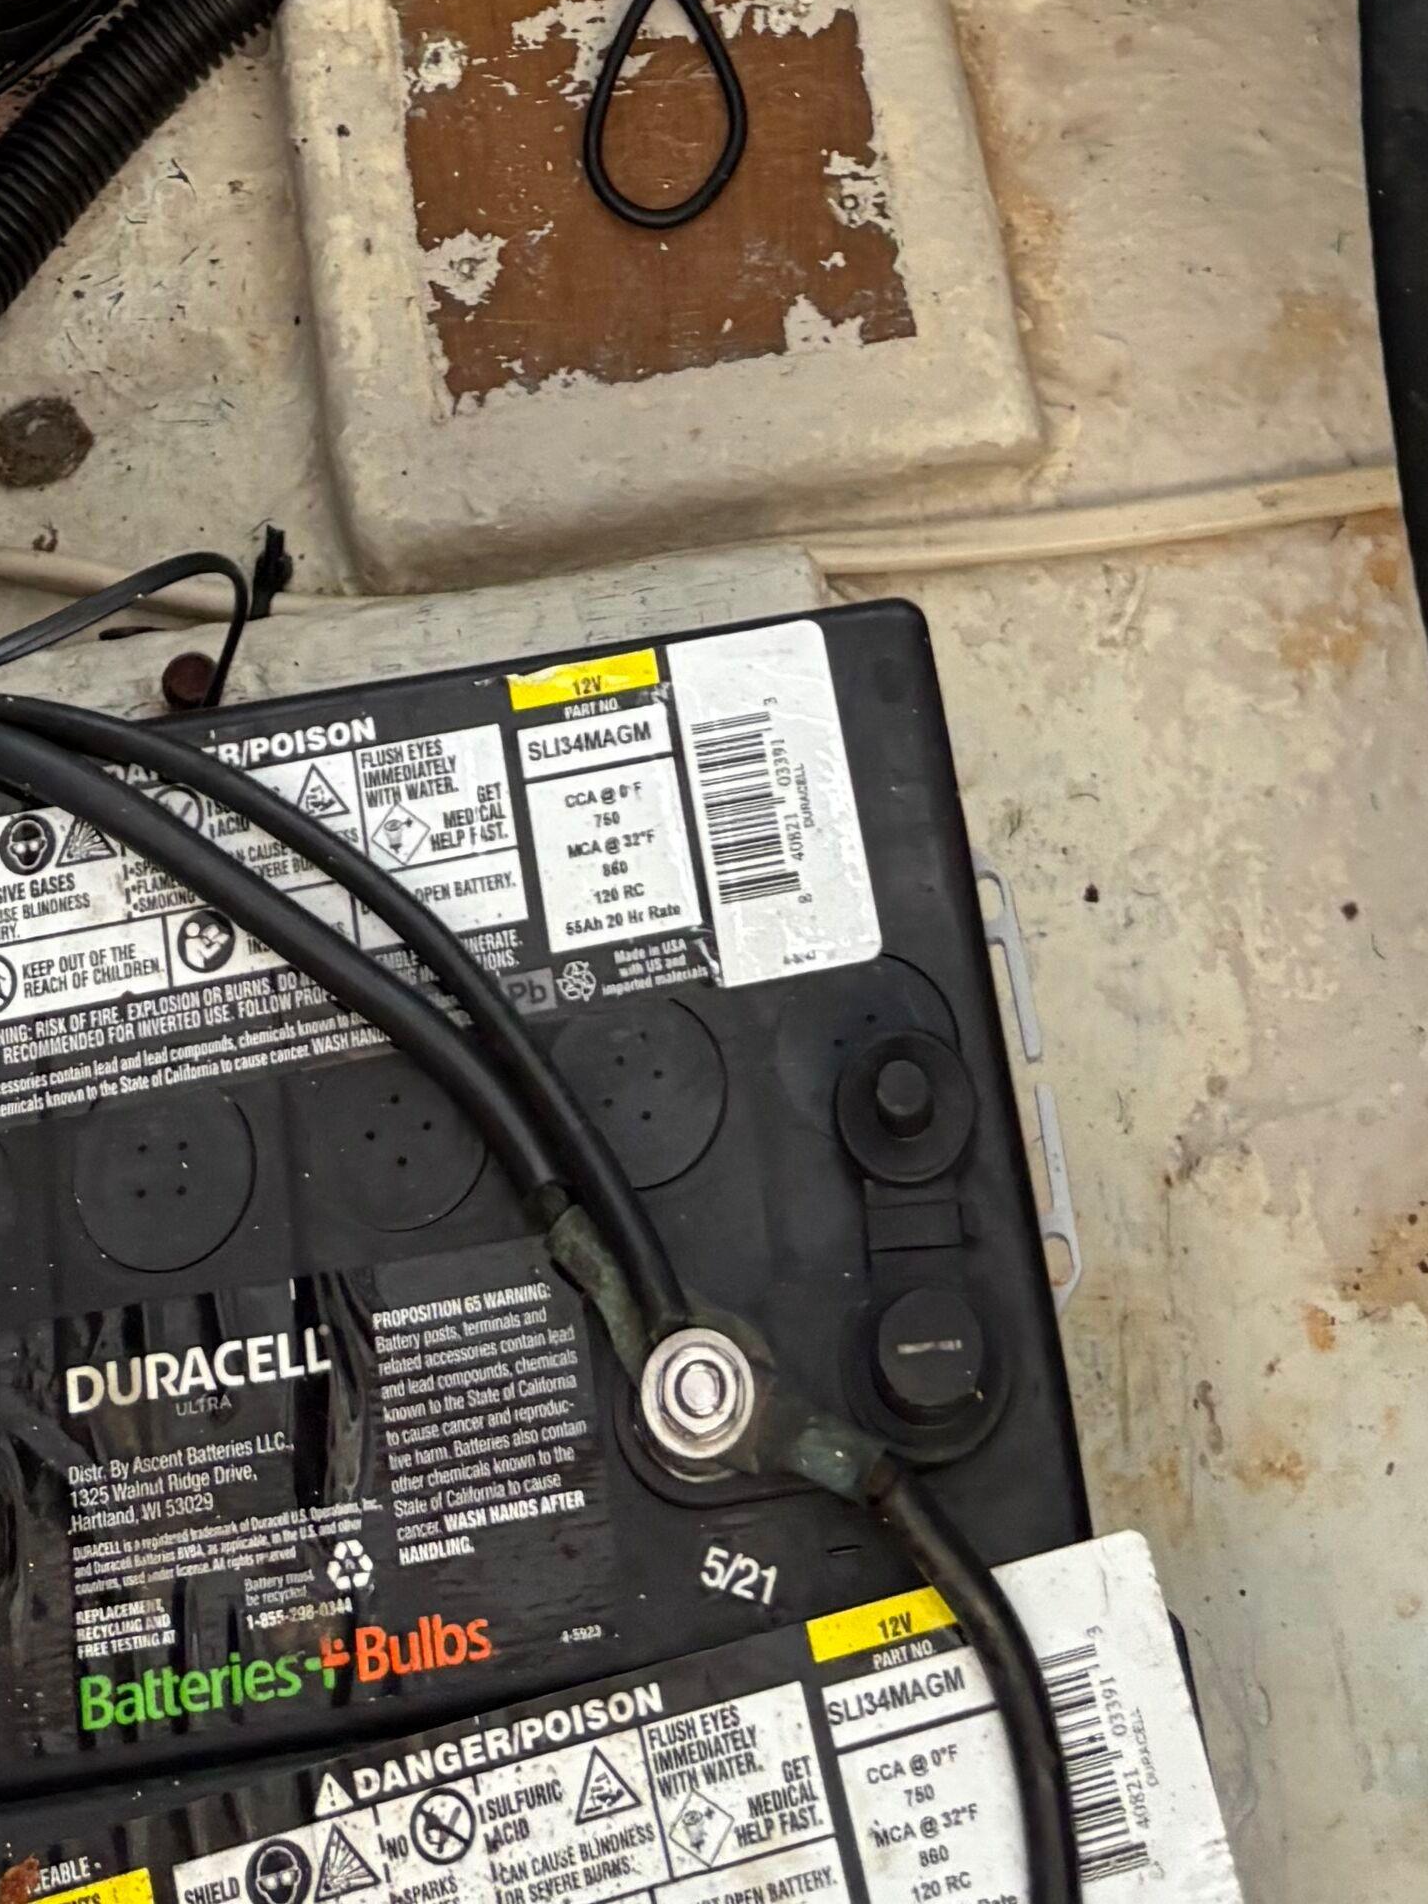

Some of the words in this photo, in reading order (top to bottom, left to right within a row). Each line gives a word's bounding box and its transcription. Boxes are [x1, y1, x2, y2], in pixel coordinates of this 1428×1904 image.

[571, 674, 604, 697] 12V
[563, 700, 598, 720] PART
[598, 696, 620, 714] NO.
[104, 715, 378, 789] DAR/POISON
[359, 745, 404, 770] FLUSH
[406, 737, 444, 761] EYES
[525, 719, 652, 762] SLI34MAGM
[361, 754, 459, 789] IMMEDIATELY
[770, 737, 793, 788] 03391
[364, 784, 403, 808] WITH
[404, 773, 460, 801] WATER.
[475, 780, 504, 804] GET
[563, 789, 598, 809] CCA
[598, 785, 617, 806] @
[794, 762, 815, 829] DURACELL
[441, 800, 507, 830] MEDICAL
[592, 809, 621, 828] 750
[428, 828, 467, 852] HELP
[566, 839, 602, 859] MCA
[603, 835, 621, 856] @
[784, 812, 805, 862] 40821
[28, 872, 76, 898] GASES
[593, 887, 620, 905] 120
[622, 881, 646, 900] RC
[20, 892, 91, 920] BLINDNESS
[564, 915, 604, 937] 55Ah
[605, 911, 624, 928] 20
[626, 907, 645, 924] Hr
[647, 900, 682, 920] Rate
[19, 958, 56, 980] KEEP
[59, 952, 86, 973] OUT
[87, 948, 108, 968] OF
[109, 942, 138, 963] THE
[612, 944, 647, 964] Made
[647, 942, 661, 958] in
[660, 937, 687, 955] USA
[21, 973, 69, 999] REACH
[70, 970, 90, 990] OF
[91, 956, 165, 986] CHILDREN.
[506, 977, 548, 1008] Pb
[600, 974, 653, 997] imported
[653, 963, 709, 987] materials
[33, 1015, 68, 1040] RISK
[68, 1011, 87, 1033] OF
[88, 1005, 124, 1028] FIRE,
[125, 989, 201, 1021] EXPLOSION
[201, 985, 224, 1007] OR
[370, 1297, 463, 1331] PROPOSITION
[462, 1293, 483, 1314] 65
[482, 1280, 552, 1310] WARNING:
[66, 1325, 333, 1415] DURACELL
[174, 1393, 232, 1418] ULTRA
[66, 1460, 108, 1487] Distr.
[108, 1456, 131, 1481] By
[130, 1447, 184, 1474] Ascent
[184, 1435, 253, 1465] Batteries
[69, 1485, 111, 1509] 1325
[111, 1475, 165, 1502] Walnut
[166, 1466, 212, 1495] Ridge
[211, 1459, 258, 1487] Drive,
[69, 1504, 139, 1536] Hartland,
[140, 1500, 162, 1521] WI
[164, 1491, 216, 1517] 53029
[442, 1506, 487, 1533] WASH
[487, 1497, 539, 1525] HANDS
[538, 1488, 586, 1514] AFTER
[399, 1533, 475, 1566] HANDLING.
[699, 1545, 778, 1606] 5/21
[74, 1616, 144, 1643] RECYCLING
[144, 1612, 172, 1632] AND
[876, 1610, 915, 1641] 12V
[75, 1639, 111, 1660] FREE
[110, 1631, 160, 1654] TESTING
[160, 1628, 178, 1646] AT
[870, 1644, 910, 1671] PART
[908, 1636, 937, 1660] NO.
[823, 1664, 967, 1728] SLI34MAGM
[1099, 1675, 1128, 1738] 03391
[352, 1682, 665, 1801] DANGER/POISON
[645, 1716, 699, 1751] FLUSH
[697, 1703, 742, 1736] EYES
[649, 1723, 761, 1775] IMMEDIATELY
[655, 1766, 701, 1799] WITH
[700, 1748, 764, 1786] WATER.
[779, 1753, 815, 1784] GET
[864, 1758, 907, 1786] CCA
[906, 1751, 931, 1779] @
[483, 1778, 566, 1821] SULFURIC
[745, 1778, 819, 1819] MEDICAL
[902, 1782, 937, 1807] 750
[1123, 1767, 1152, 1830] 40821
[491, 1816, 532, 1847] ACID
[732, 1815, 778, 1849] HELP
[777, 1802, 824, 1836] FAST.
[871, 1820, 917, 1849] MCA
[916, 1813, 941, 1840] @
[939, 1801, 981, 1829] 32°F
[383, 1833, 411, 1861] NO
[496, 1859, 529, 1886] CAN
[528, 1845, 577, 1877] CAUSE
[576, 1821, 657, 1862] BLINDNESS
[917, 1843, 951, 1869] 860
[183, 1875, 242, 1904] SHIELD
[768, 1865, 839, 1903] BATTERY.
[911, 1878, 942, 1903] 120
[943, 1869, 973, 1894] RC
